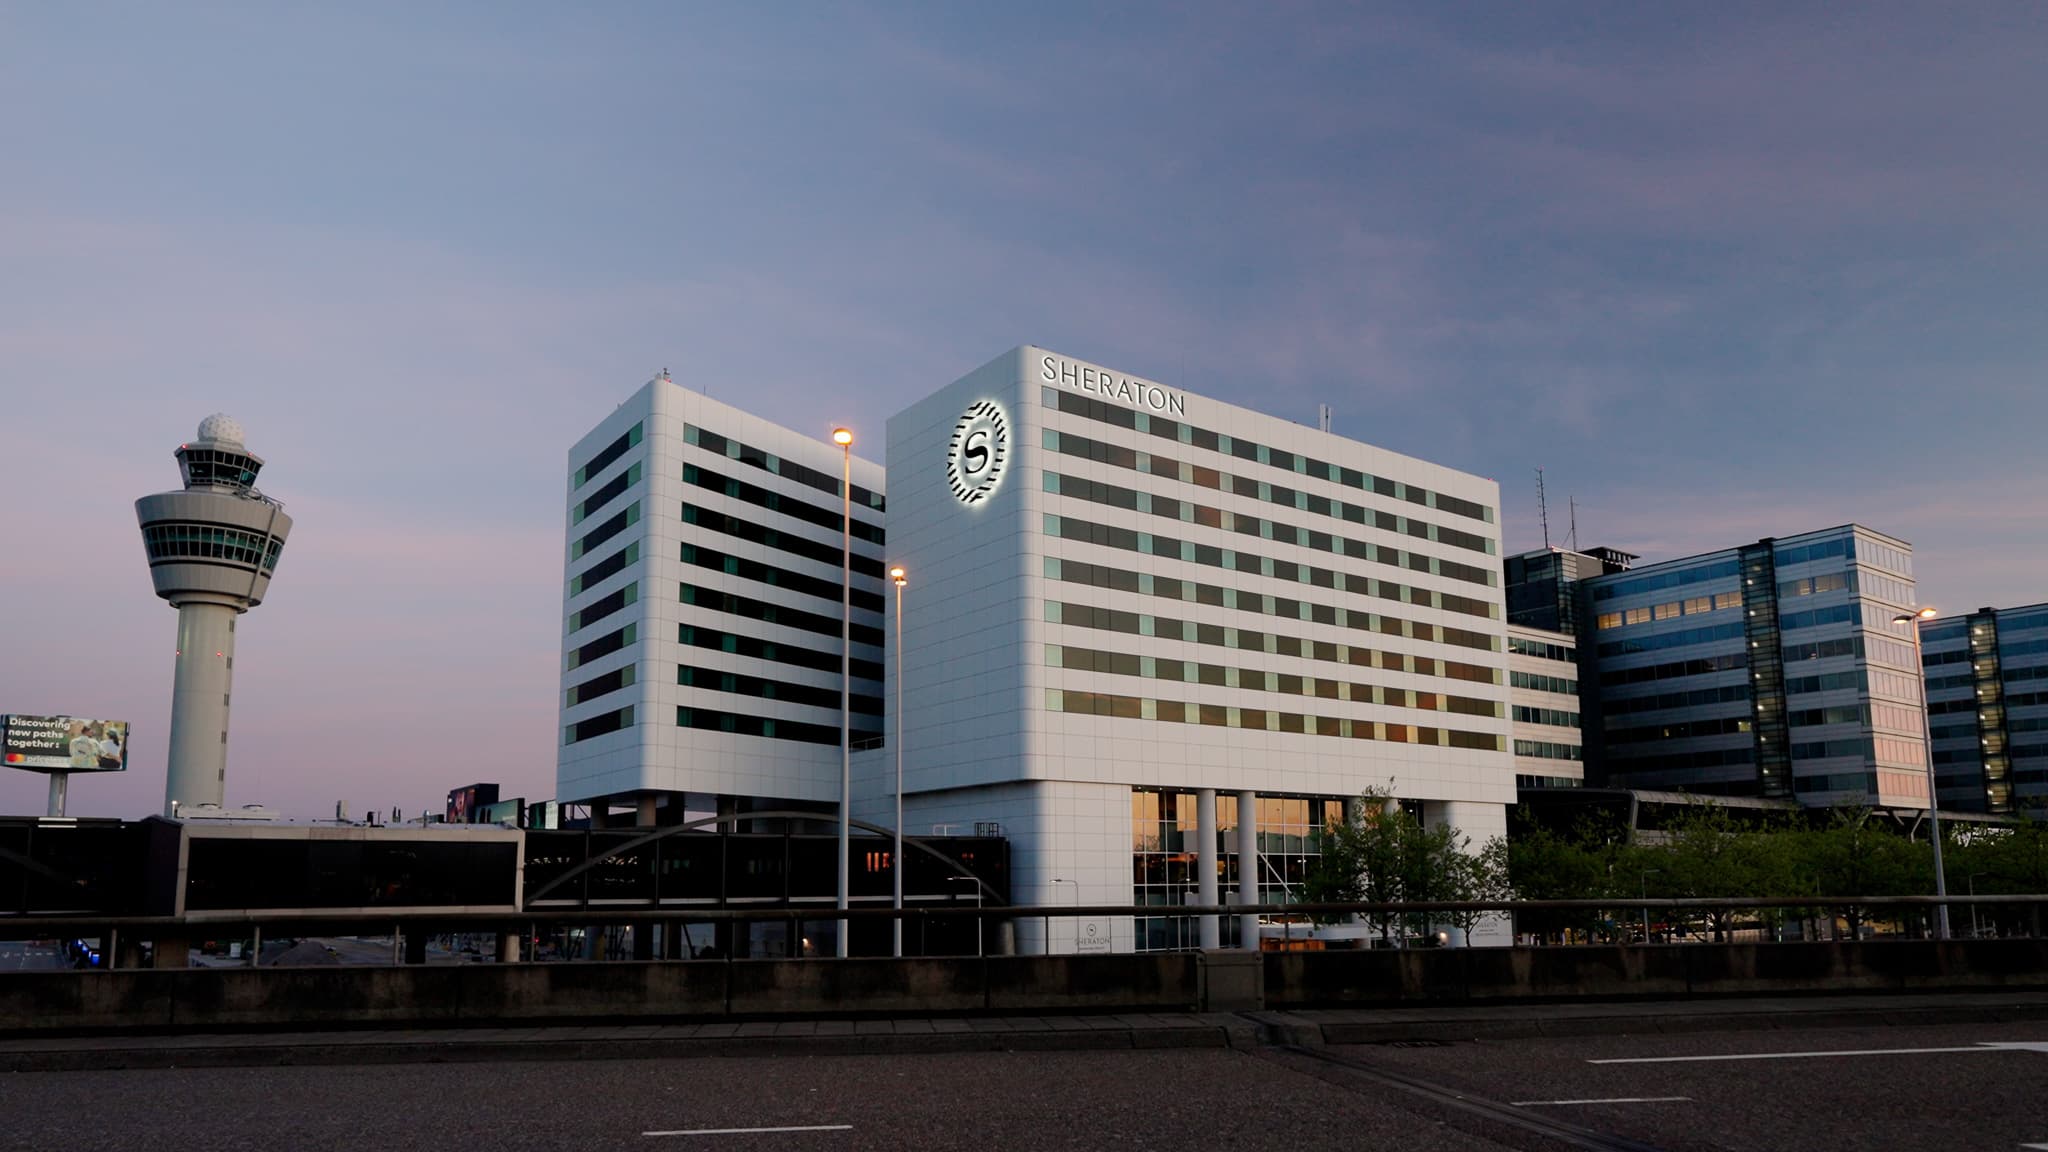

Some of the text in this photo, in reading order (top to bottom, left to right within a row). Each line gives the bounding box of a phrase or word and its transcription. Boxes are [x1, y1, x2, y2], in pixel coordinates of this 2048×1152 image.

[1041, 356, 1186, 417] SHERATON
[964, 431, 989, 474] S
[8, 729, 64, 739] new paths
[9, 718, 71, 731] Discovering
